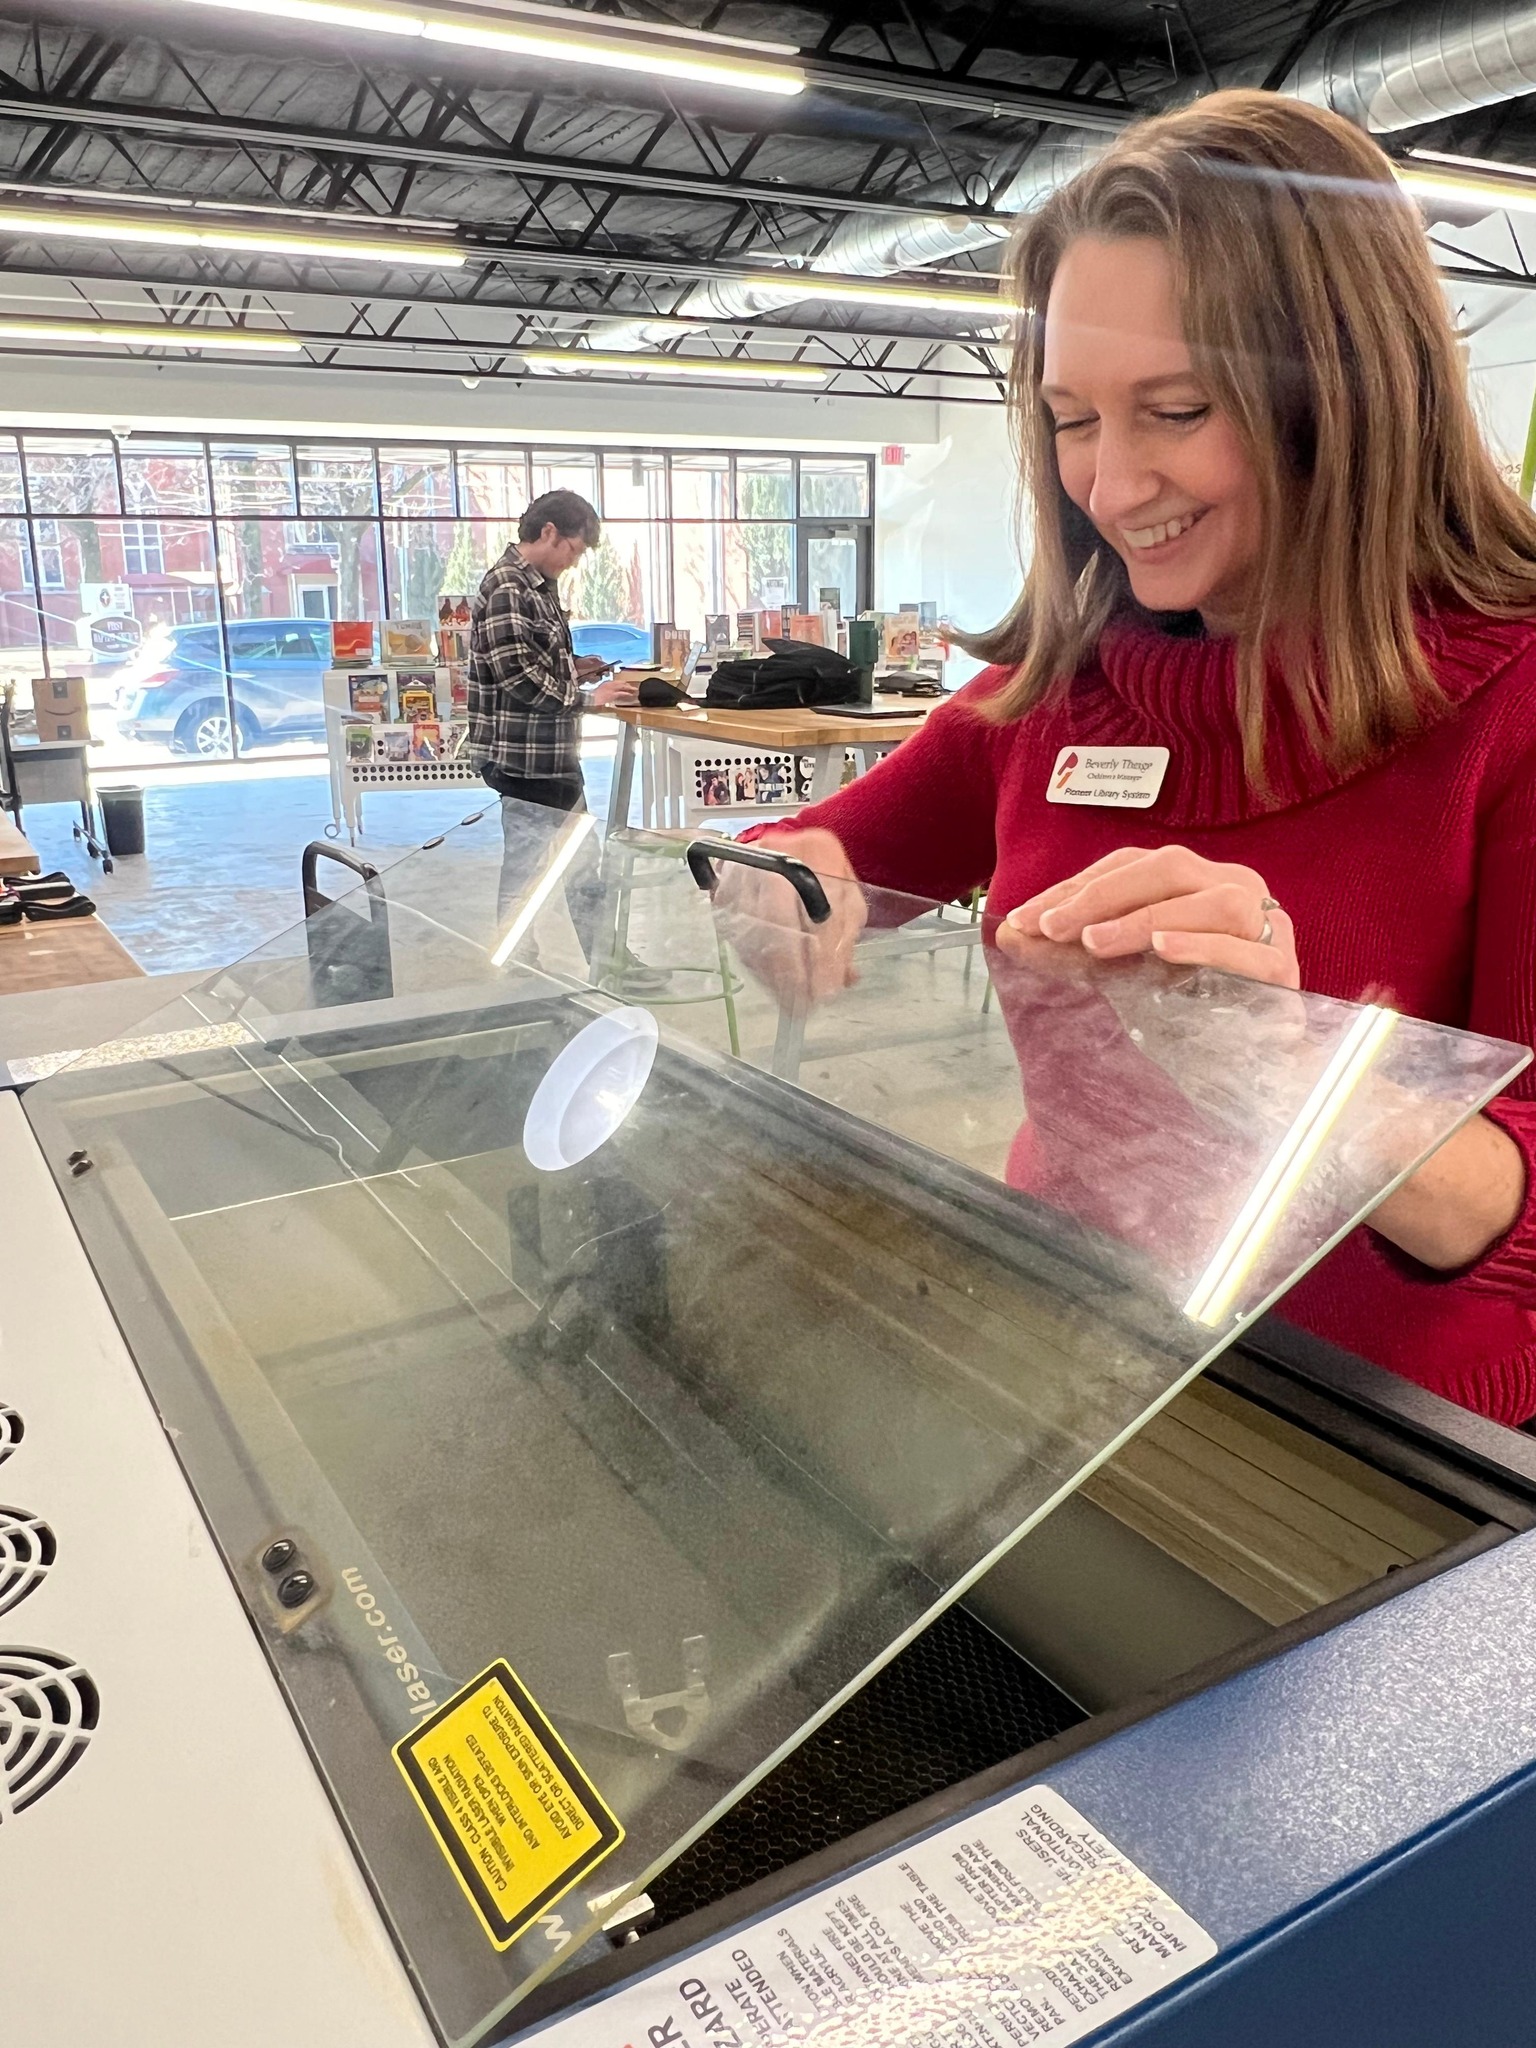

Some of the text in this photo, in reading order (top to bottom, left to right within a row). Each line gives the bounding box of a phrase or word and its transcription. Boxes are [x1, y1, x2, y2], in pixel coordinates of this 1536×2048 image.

[1085, 758, 1119, 771] Beverly
[1064, 788, 1150, 800] Pioneer Library System
[341, 1567, 438, 1720] laser.com
[426, 1756, 443, 1776] AND
[480, 1704, 572, 1839] AVOID EYE OR SKIN EXPOSURE TO
[492, 1695, 585, 1830] DIRECT OR SCATTERED RADIATION
[436, 1774, 461, 1808] VISIBLE
[464, 1733, 540, 1850] AND INTERLOCKS DEFEATED
[470, 1773, 508, 1827] WHEN OPEN
[441, 1753, 515, 1872] INVISIBLE LASER RADIATION
[457, 1812, 482, 1844] CLASS
[960, 1843, 982, 1864] AND
[972, 1838, 993, 1858] THE
[477, 1847, 508, 1891] CAUTION
[898, 1861, 930, 1893] TABLE
[951, 1851, 981, 1880] FROM
[990, 1858, 1022, 1888] FROM
[954, 1872, 977, 1894] THE
[978, 1862, 1024, 1908] MACHINE
[832, 1896, 863, 1929] TIMES.
[847, 1893, 871, 1917] FIRE
[899, 1901, 921, 1922] THE
[913, 1896, 937, 1920] AND
[925, 1891, 947, 1913] THE
[825, 1908, 851, 1936] KEPT
[821, 1925, 846, 1951] FIRE
[847, 1936, 865, 1953] BE
[857, 1928, 882, 1952] ALL
[880, 1934, 895, 1945] A
[776, 1927, 825, 1986] MATERIALS
[776, 1949, 808, 1984] WHEN
[874, 1949, 893, 1966] AT
[1084, 1974, 1110, 1998] THE
[1037, 1996, 1066, 2025] PAN.
